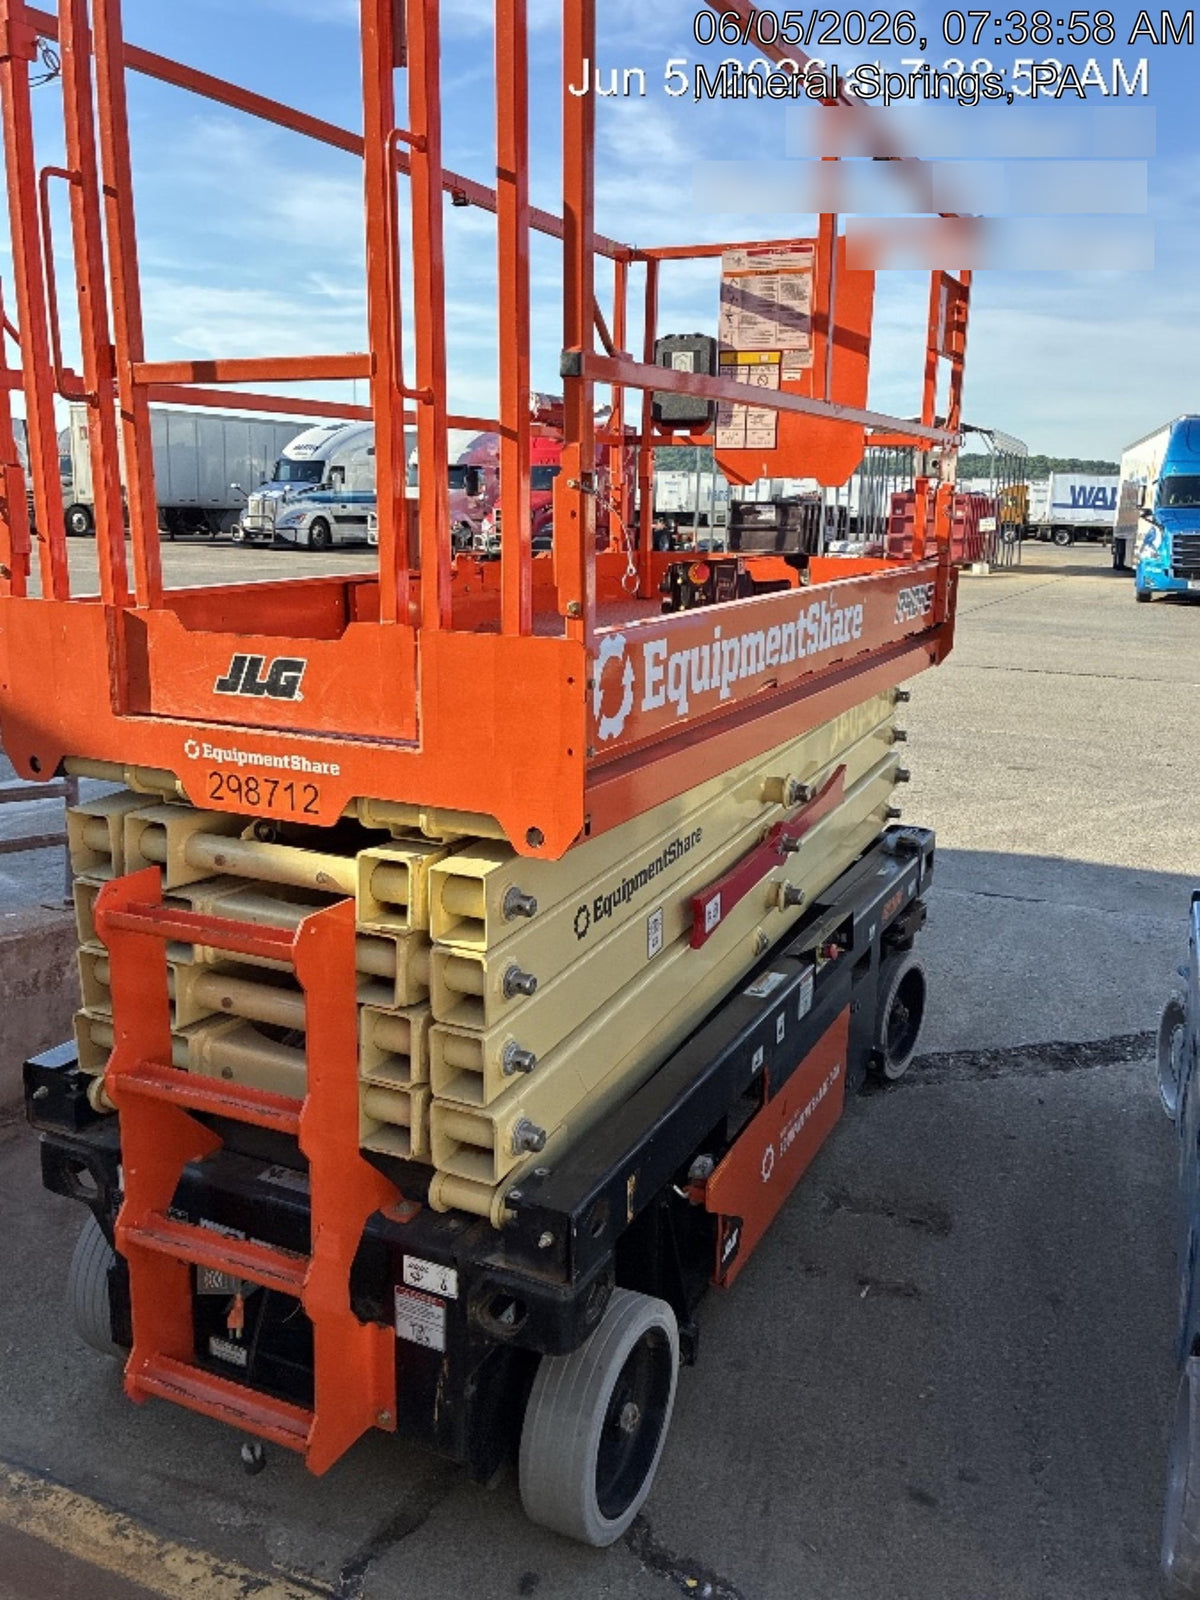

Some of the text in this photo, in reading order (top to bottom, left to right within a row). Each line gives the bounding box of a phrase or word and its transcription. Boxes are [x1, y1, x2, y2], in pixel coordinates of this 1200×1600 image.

[213, 652, 308, 702] JLG
[641, 600, 865, 716] EquipmentShare
[202, 742, 342, 776] EquipmentShare
[208, 771, 320, 815] 298712
[592, 827, 704, 924] EquipmentShare
